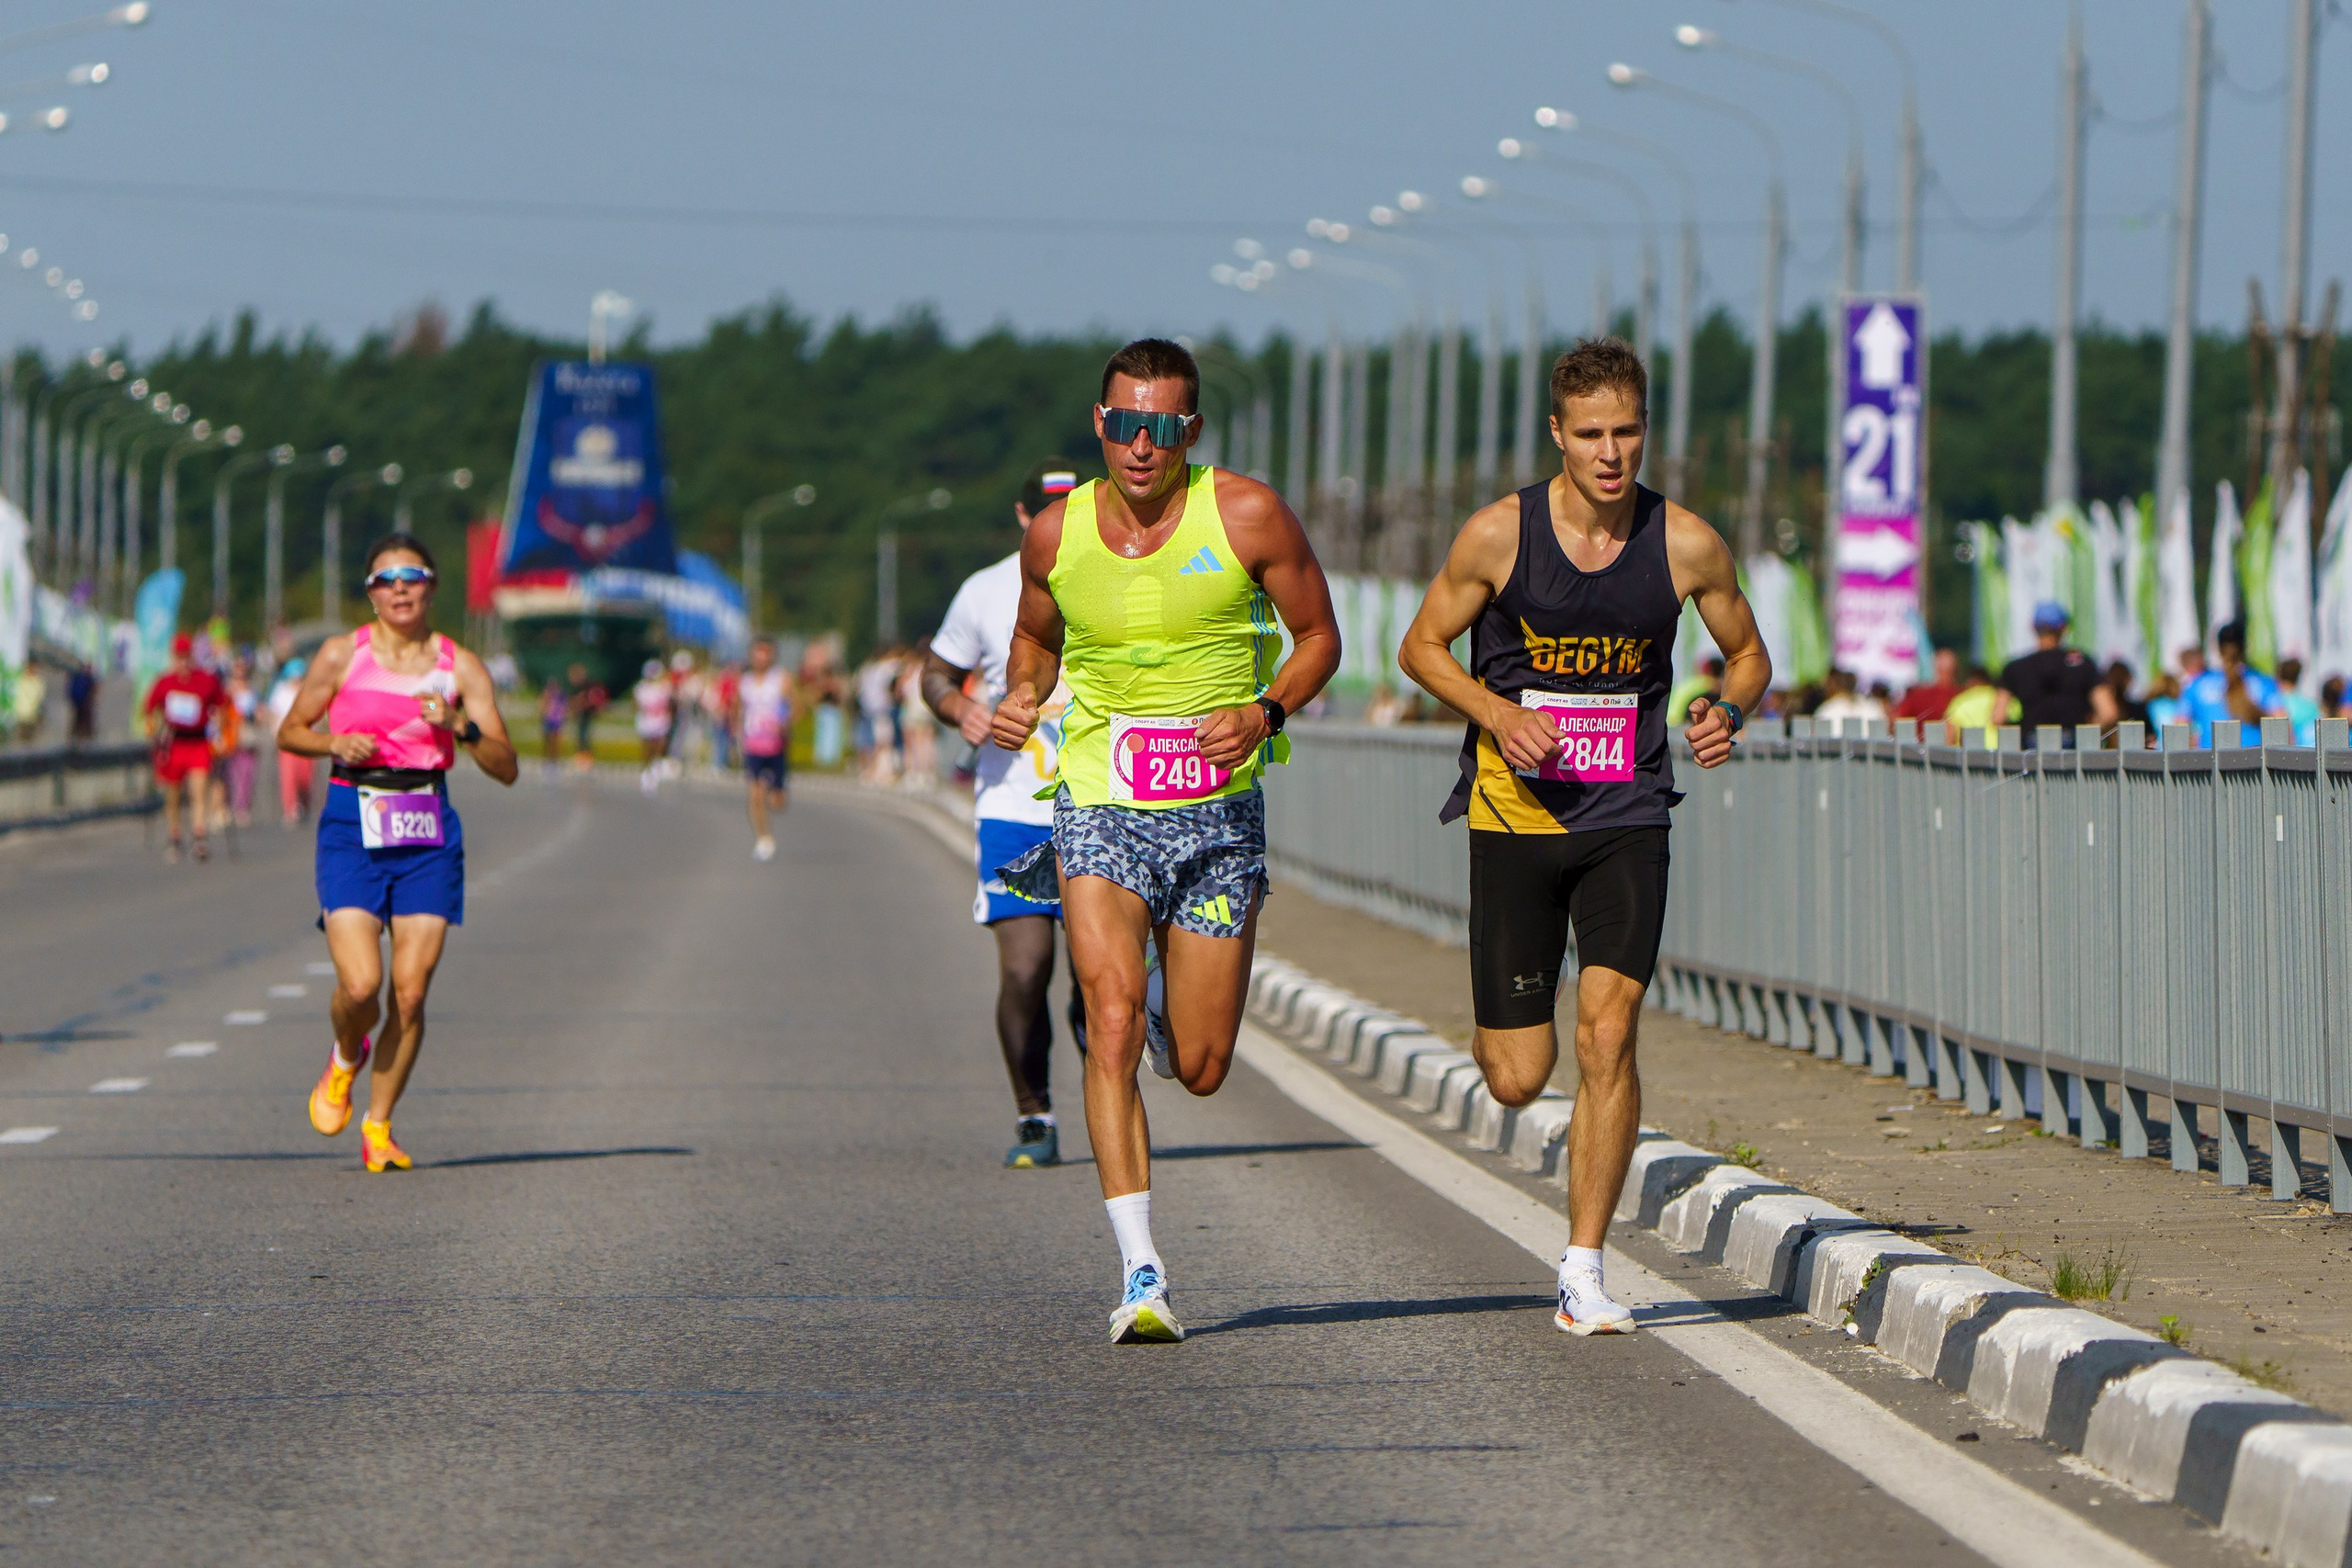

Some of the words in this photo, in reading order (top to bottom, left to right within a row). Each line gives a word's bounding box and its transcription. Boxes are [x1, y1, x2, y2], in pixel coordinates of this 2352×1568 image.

[1843, 405, 1915, 501] 21
[1524, 637, 1652, 676] BEGYM
[1559, 717, 1626, 733] АЛЕКСАНДР
[1148, 738, 1201, 752] АЛЕКСАН
[1557, 737, 1624, 771] 2844
[390, 811, 437, 840] 5220
